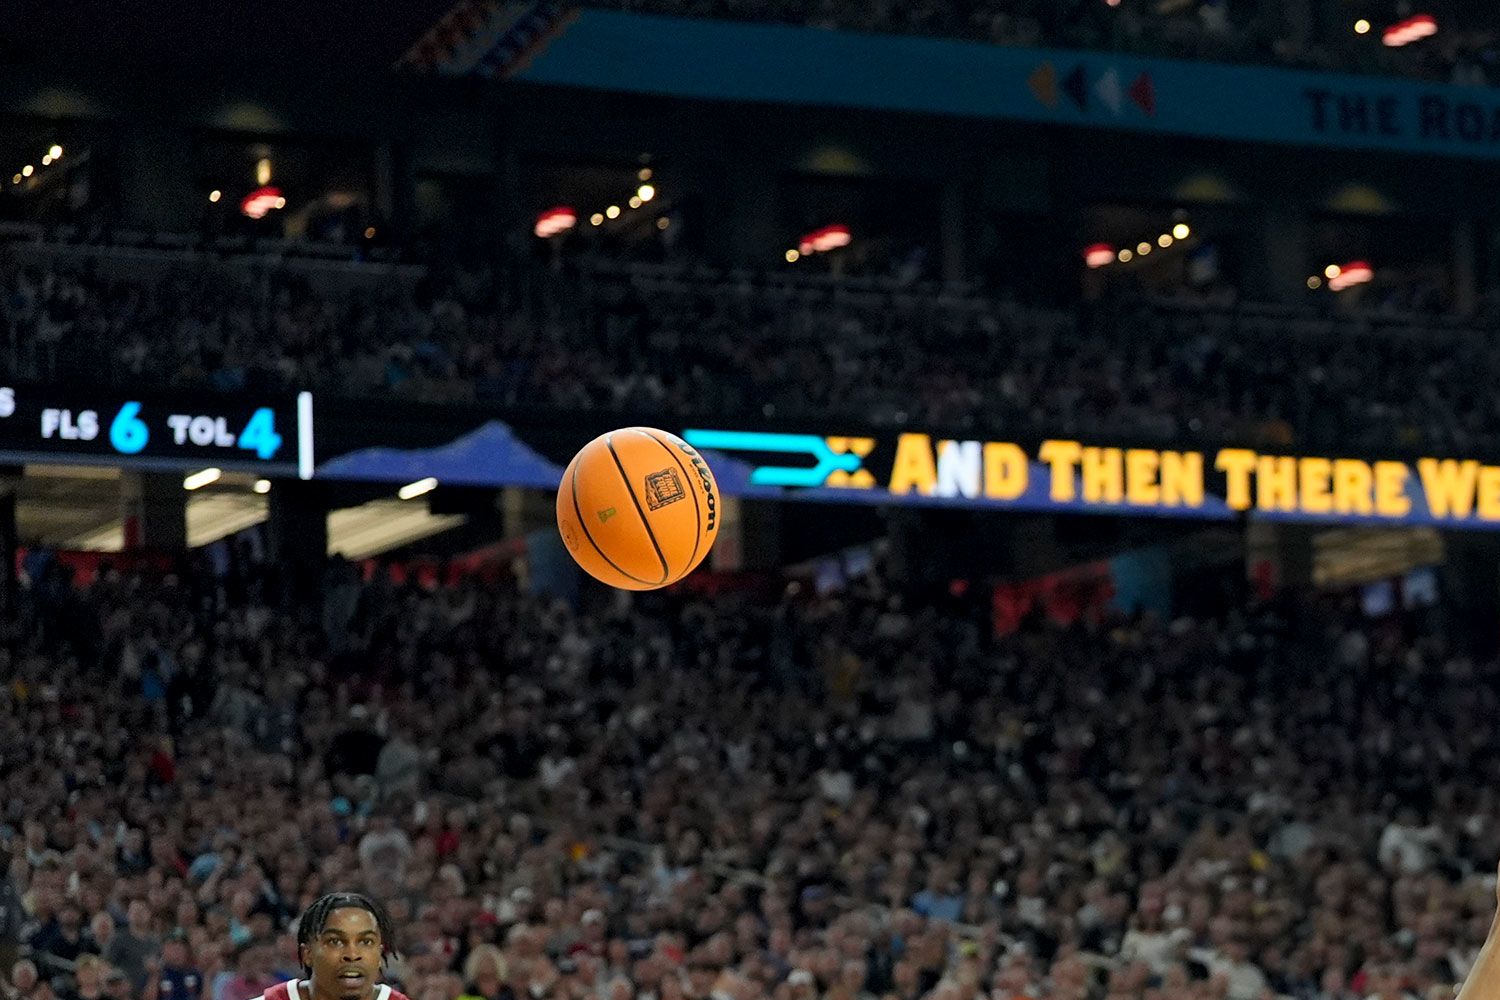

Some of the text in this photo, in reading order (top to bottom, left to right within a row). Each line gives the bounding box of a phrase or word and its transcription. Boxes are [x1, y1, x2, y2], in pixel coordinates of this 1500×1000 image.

[1305, 89, 1402, 136] THE
[41, 401, 283, 460] FLS 6 TOL 4
[889, 432, 1029, 499] AND
[1039, 440, 1204, 507] THEN
[1214, 448, 1411, 517] THERE
